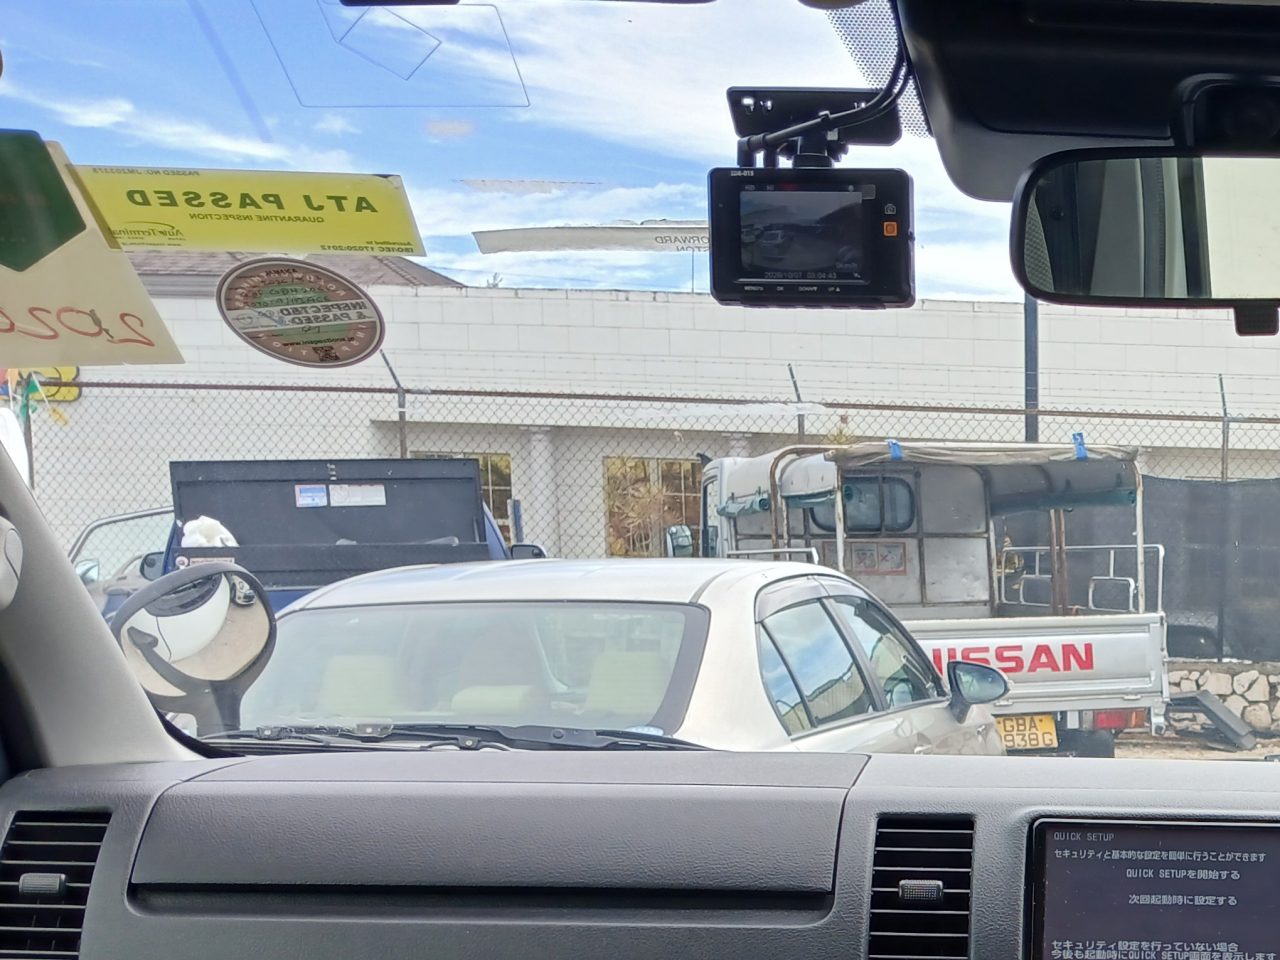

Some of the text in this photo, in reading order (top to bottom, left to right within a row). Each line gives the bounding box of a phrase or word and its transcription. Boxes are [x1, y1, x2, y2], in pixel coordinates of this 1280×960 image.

[1002, 717, 1039, 733] GBA
[1053, 832, 1115, 841] QUICK SETUP
[1126, 868, 1241, 880] QUICK SETUPを開始する
[1128, 894, 1237, 906] 次回起動時に設定する
[1051, 940, 1239, 952] セキュリティ設定を行っていない場合
